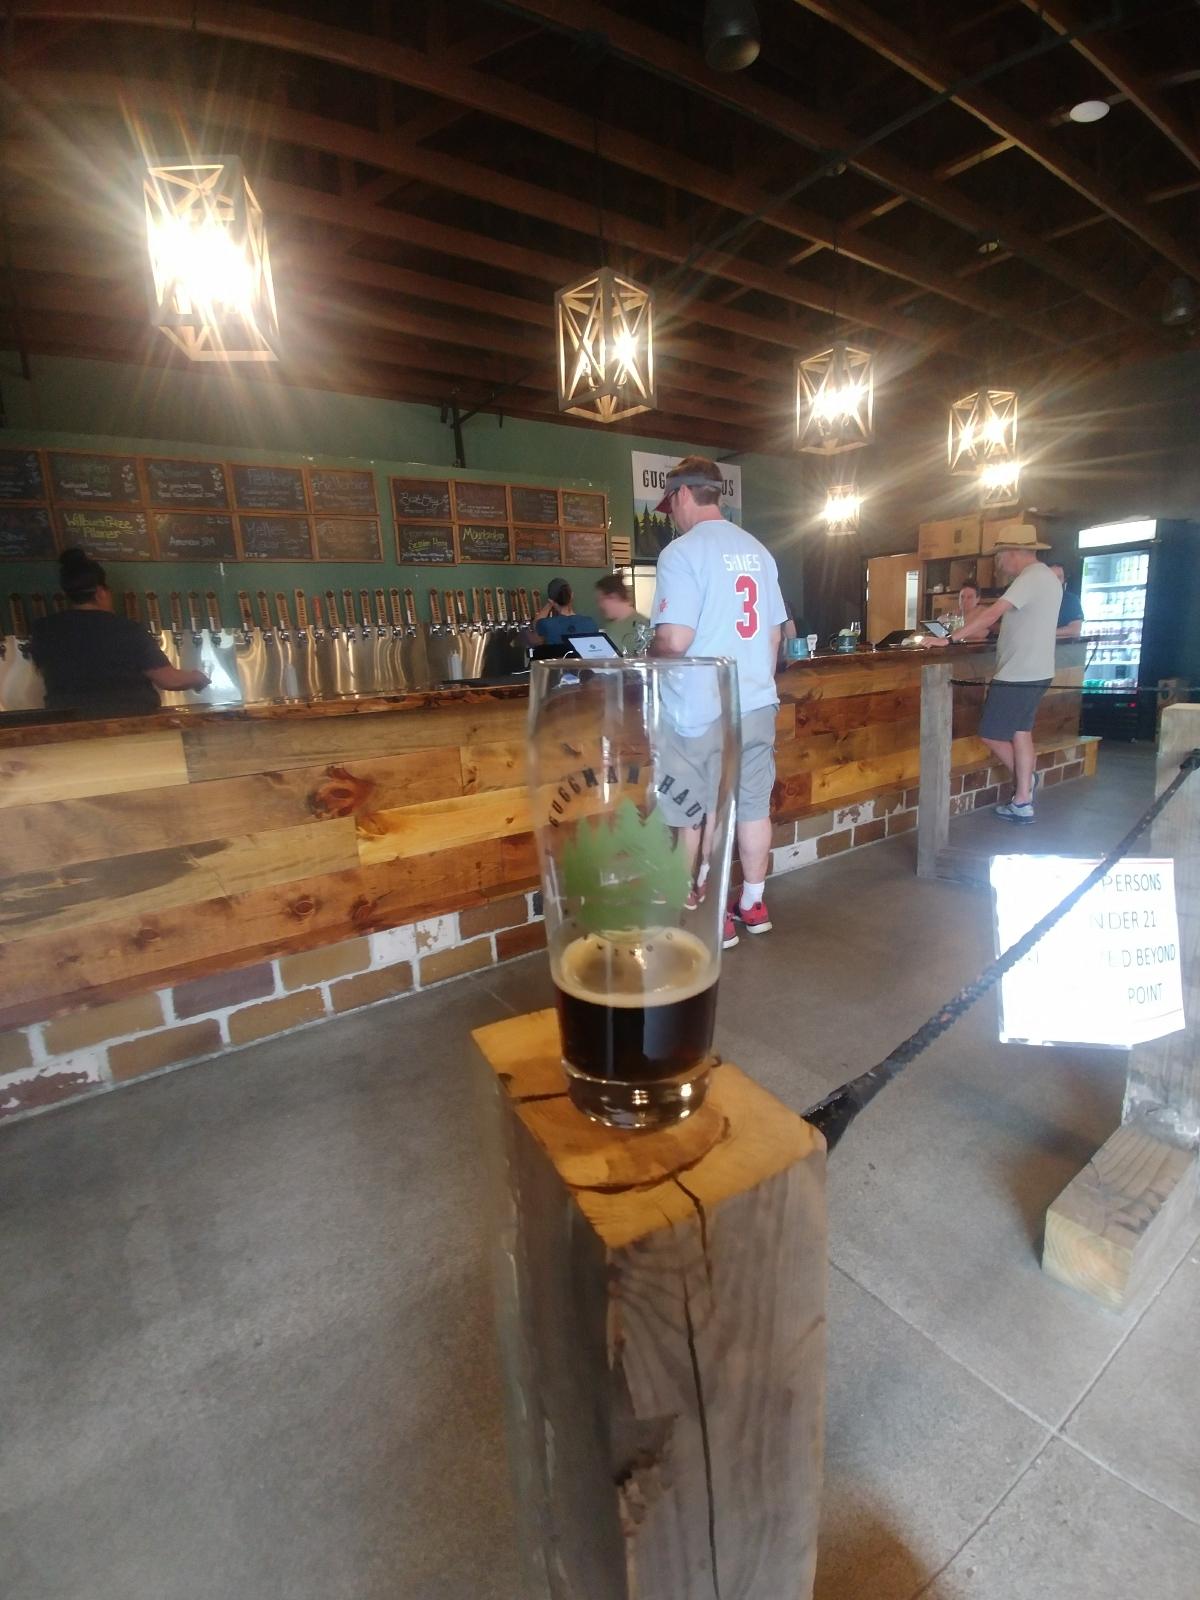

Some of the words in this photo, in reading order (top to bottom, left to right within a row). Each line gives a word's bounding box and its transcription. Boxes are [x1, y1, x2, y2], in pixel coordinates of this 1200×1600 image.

[735, 573, 760, 640] 3
[1101, 873, 1162, 892] PERSONS
[1089, 911, 1139, 930] NDER
[1143, 910, 1157, 929] 21
[1136, 944, 1176, 967] BEYOND
[1127, 983, 1163, 1004] POINT
